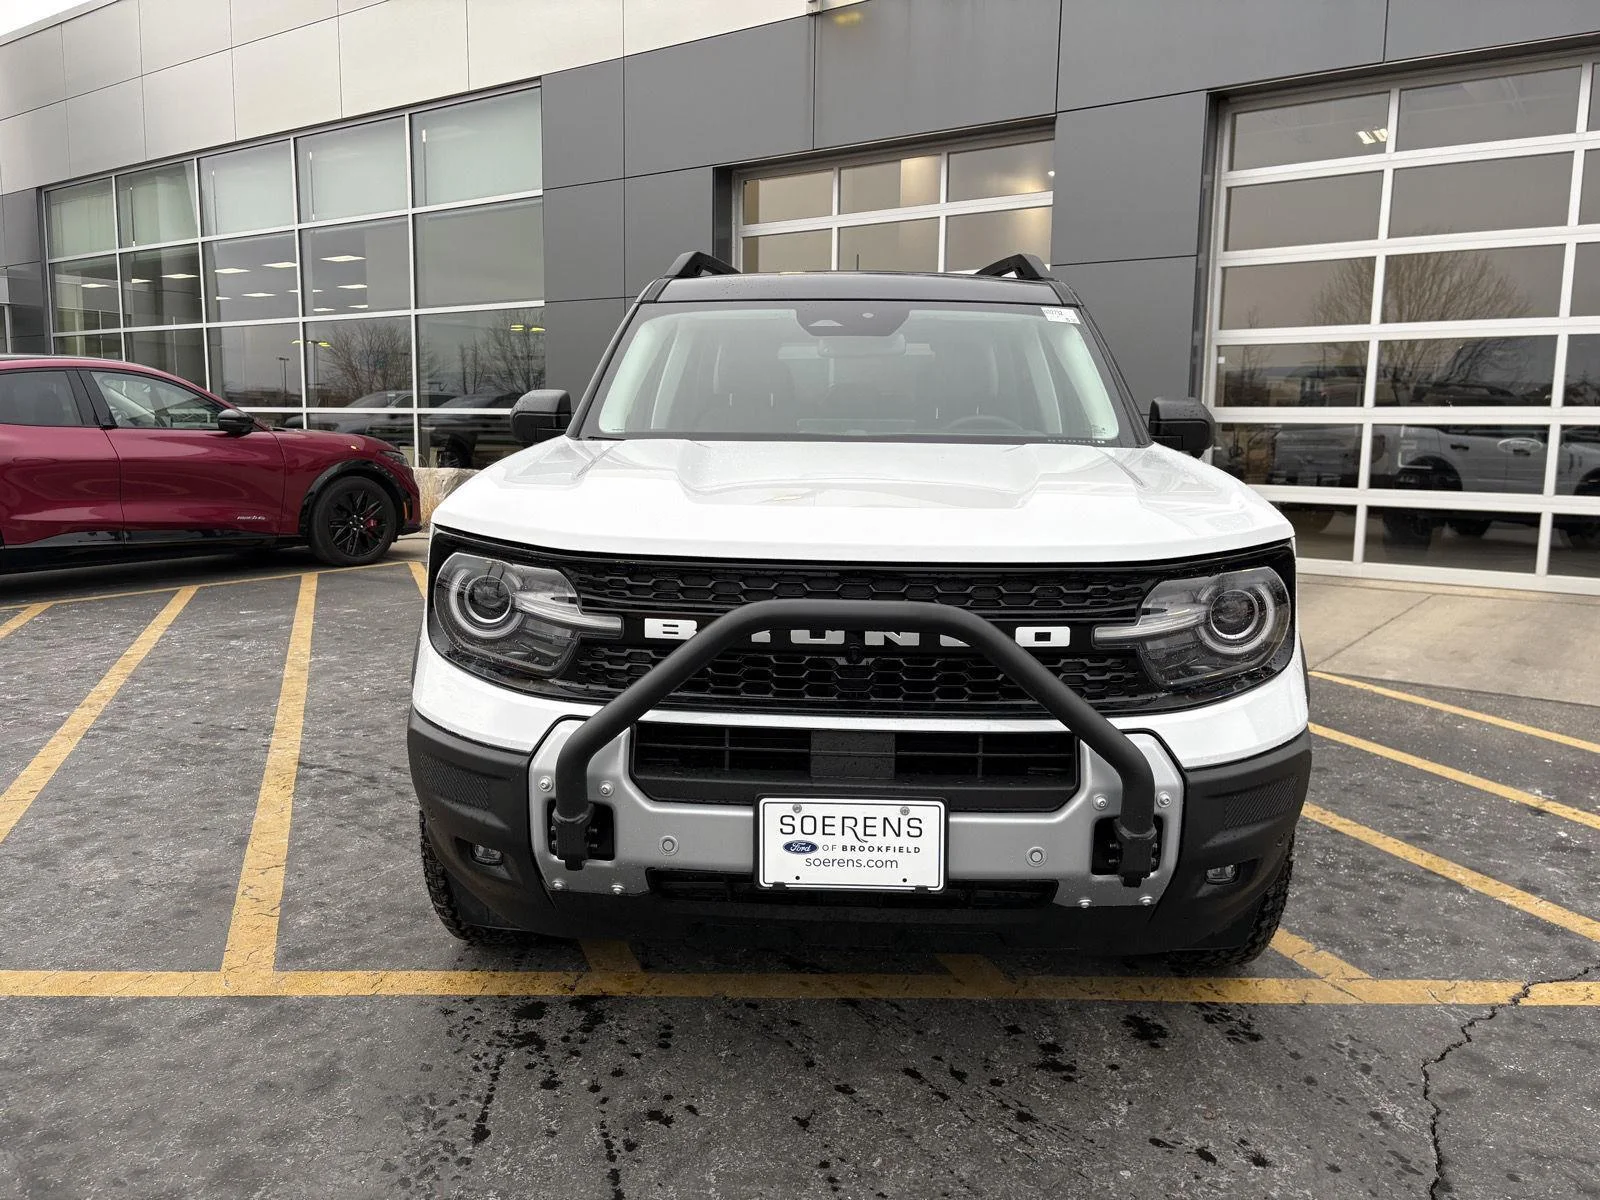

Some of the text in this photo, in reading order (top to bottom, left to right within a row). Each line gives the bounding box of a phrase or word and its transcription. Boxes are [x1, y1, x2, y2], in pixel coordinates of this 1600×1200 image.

[779, 814, 924, 843] SOERENS
[788, 841, 813, 853] Ford
[821, 844, 921, 854] OF BROOKFIELD
[804, 856, 899, 869] soerens.com
